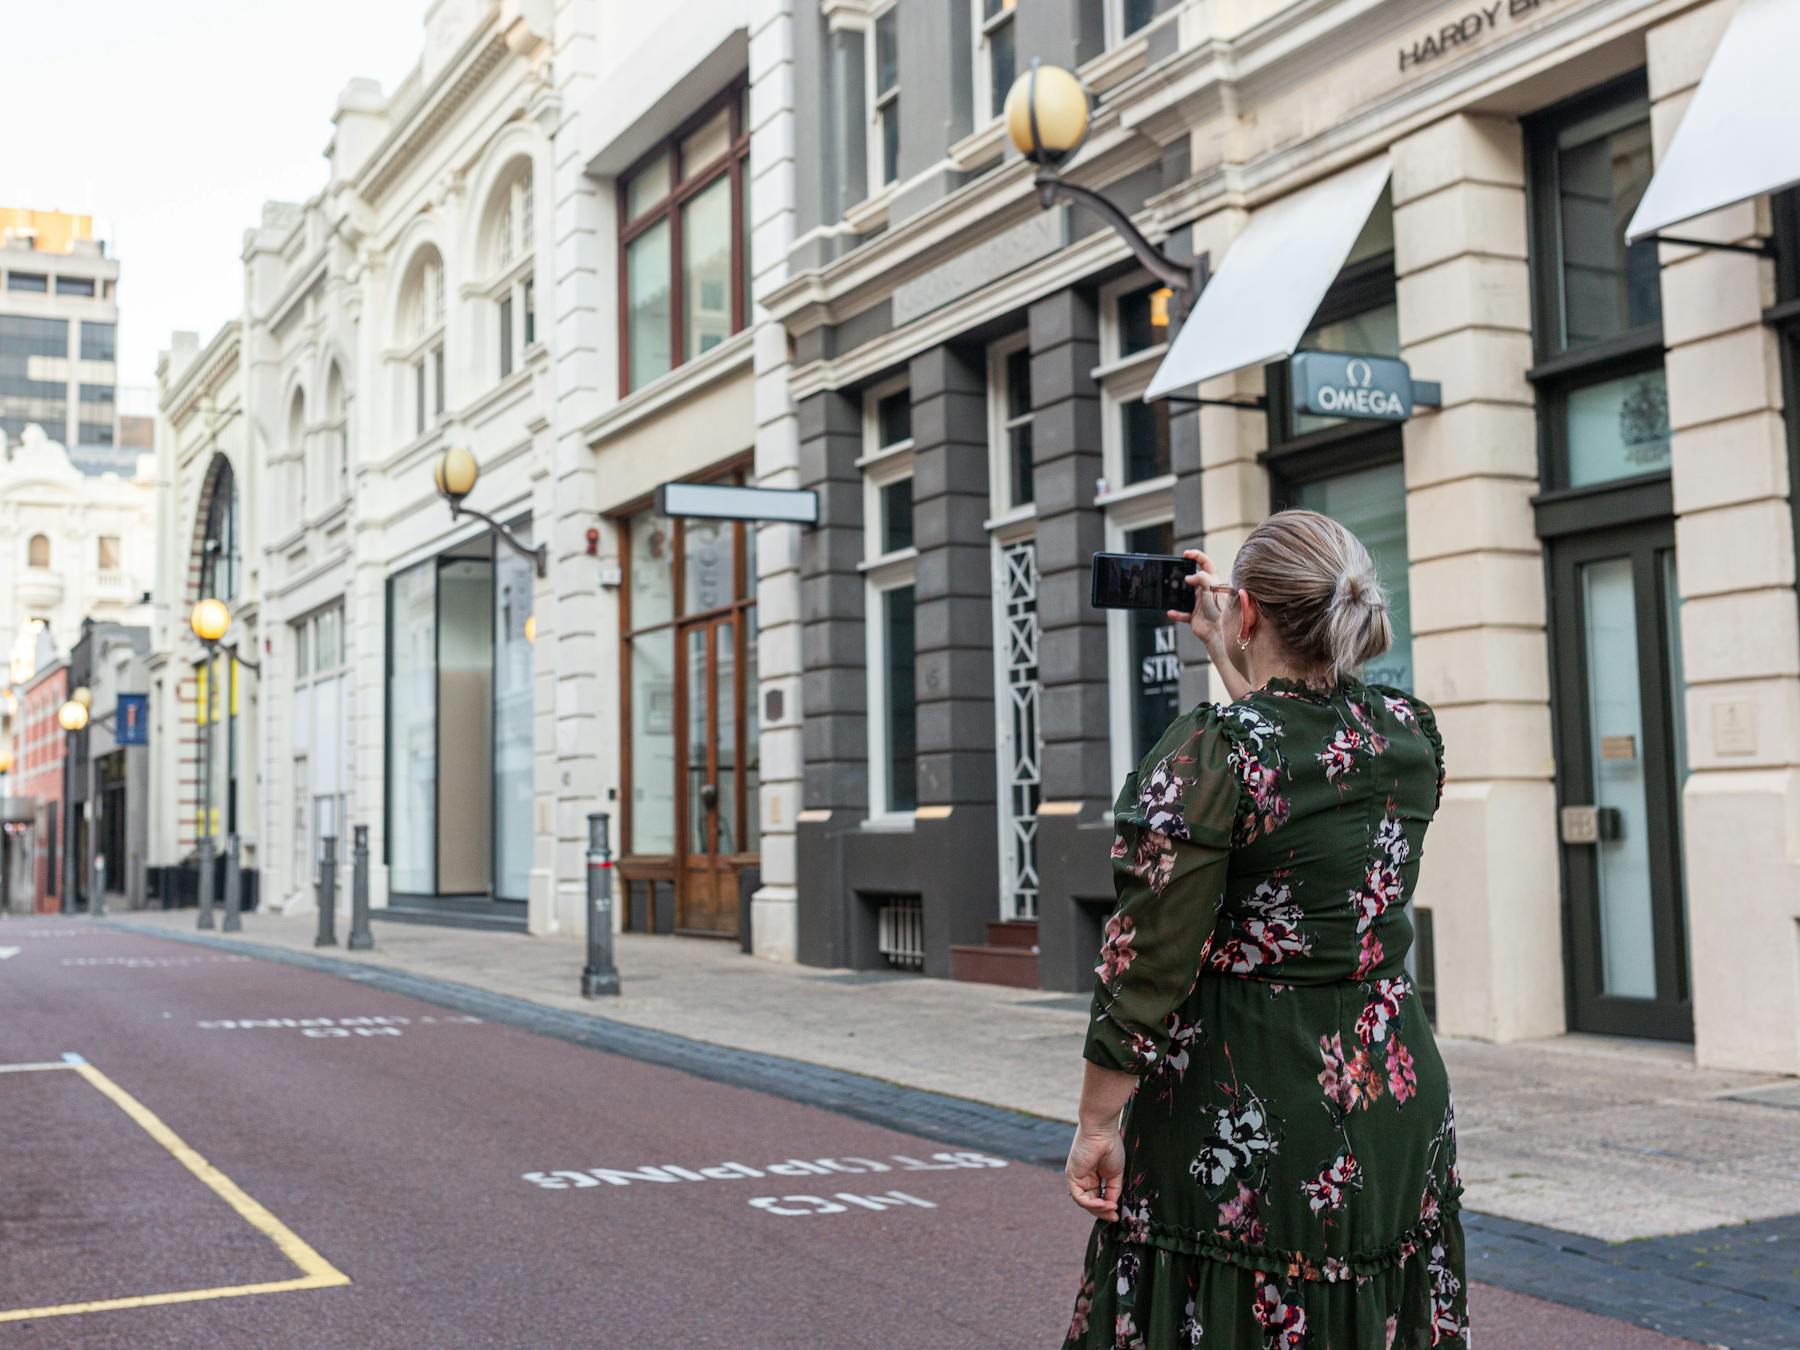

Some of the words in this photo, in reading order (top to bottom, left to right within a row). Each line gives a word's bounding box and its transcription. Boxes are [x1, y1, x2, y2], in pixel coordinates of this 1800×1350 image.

[1398, 1, 1500, 72] HARDY
[1318, 385, 1404, 415] OMEGA
[521, 1152, 1009, 1189] STOPPING
[747, 1190, 938, 1216] NO
